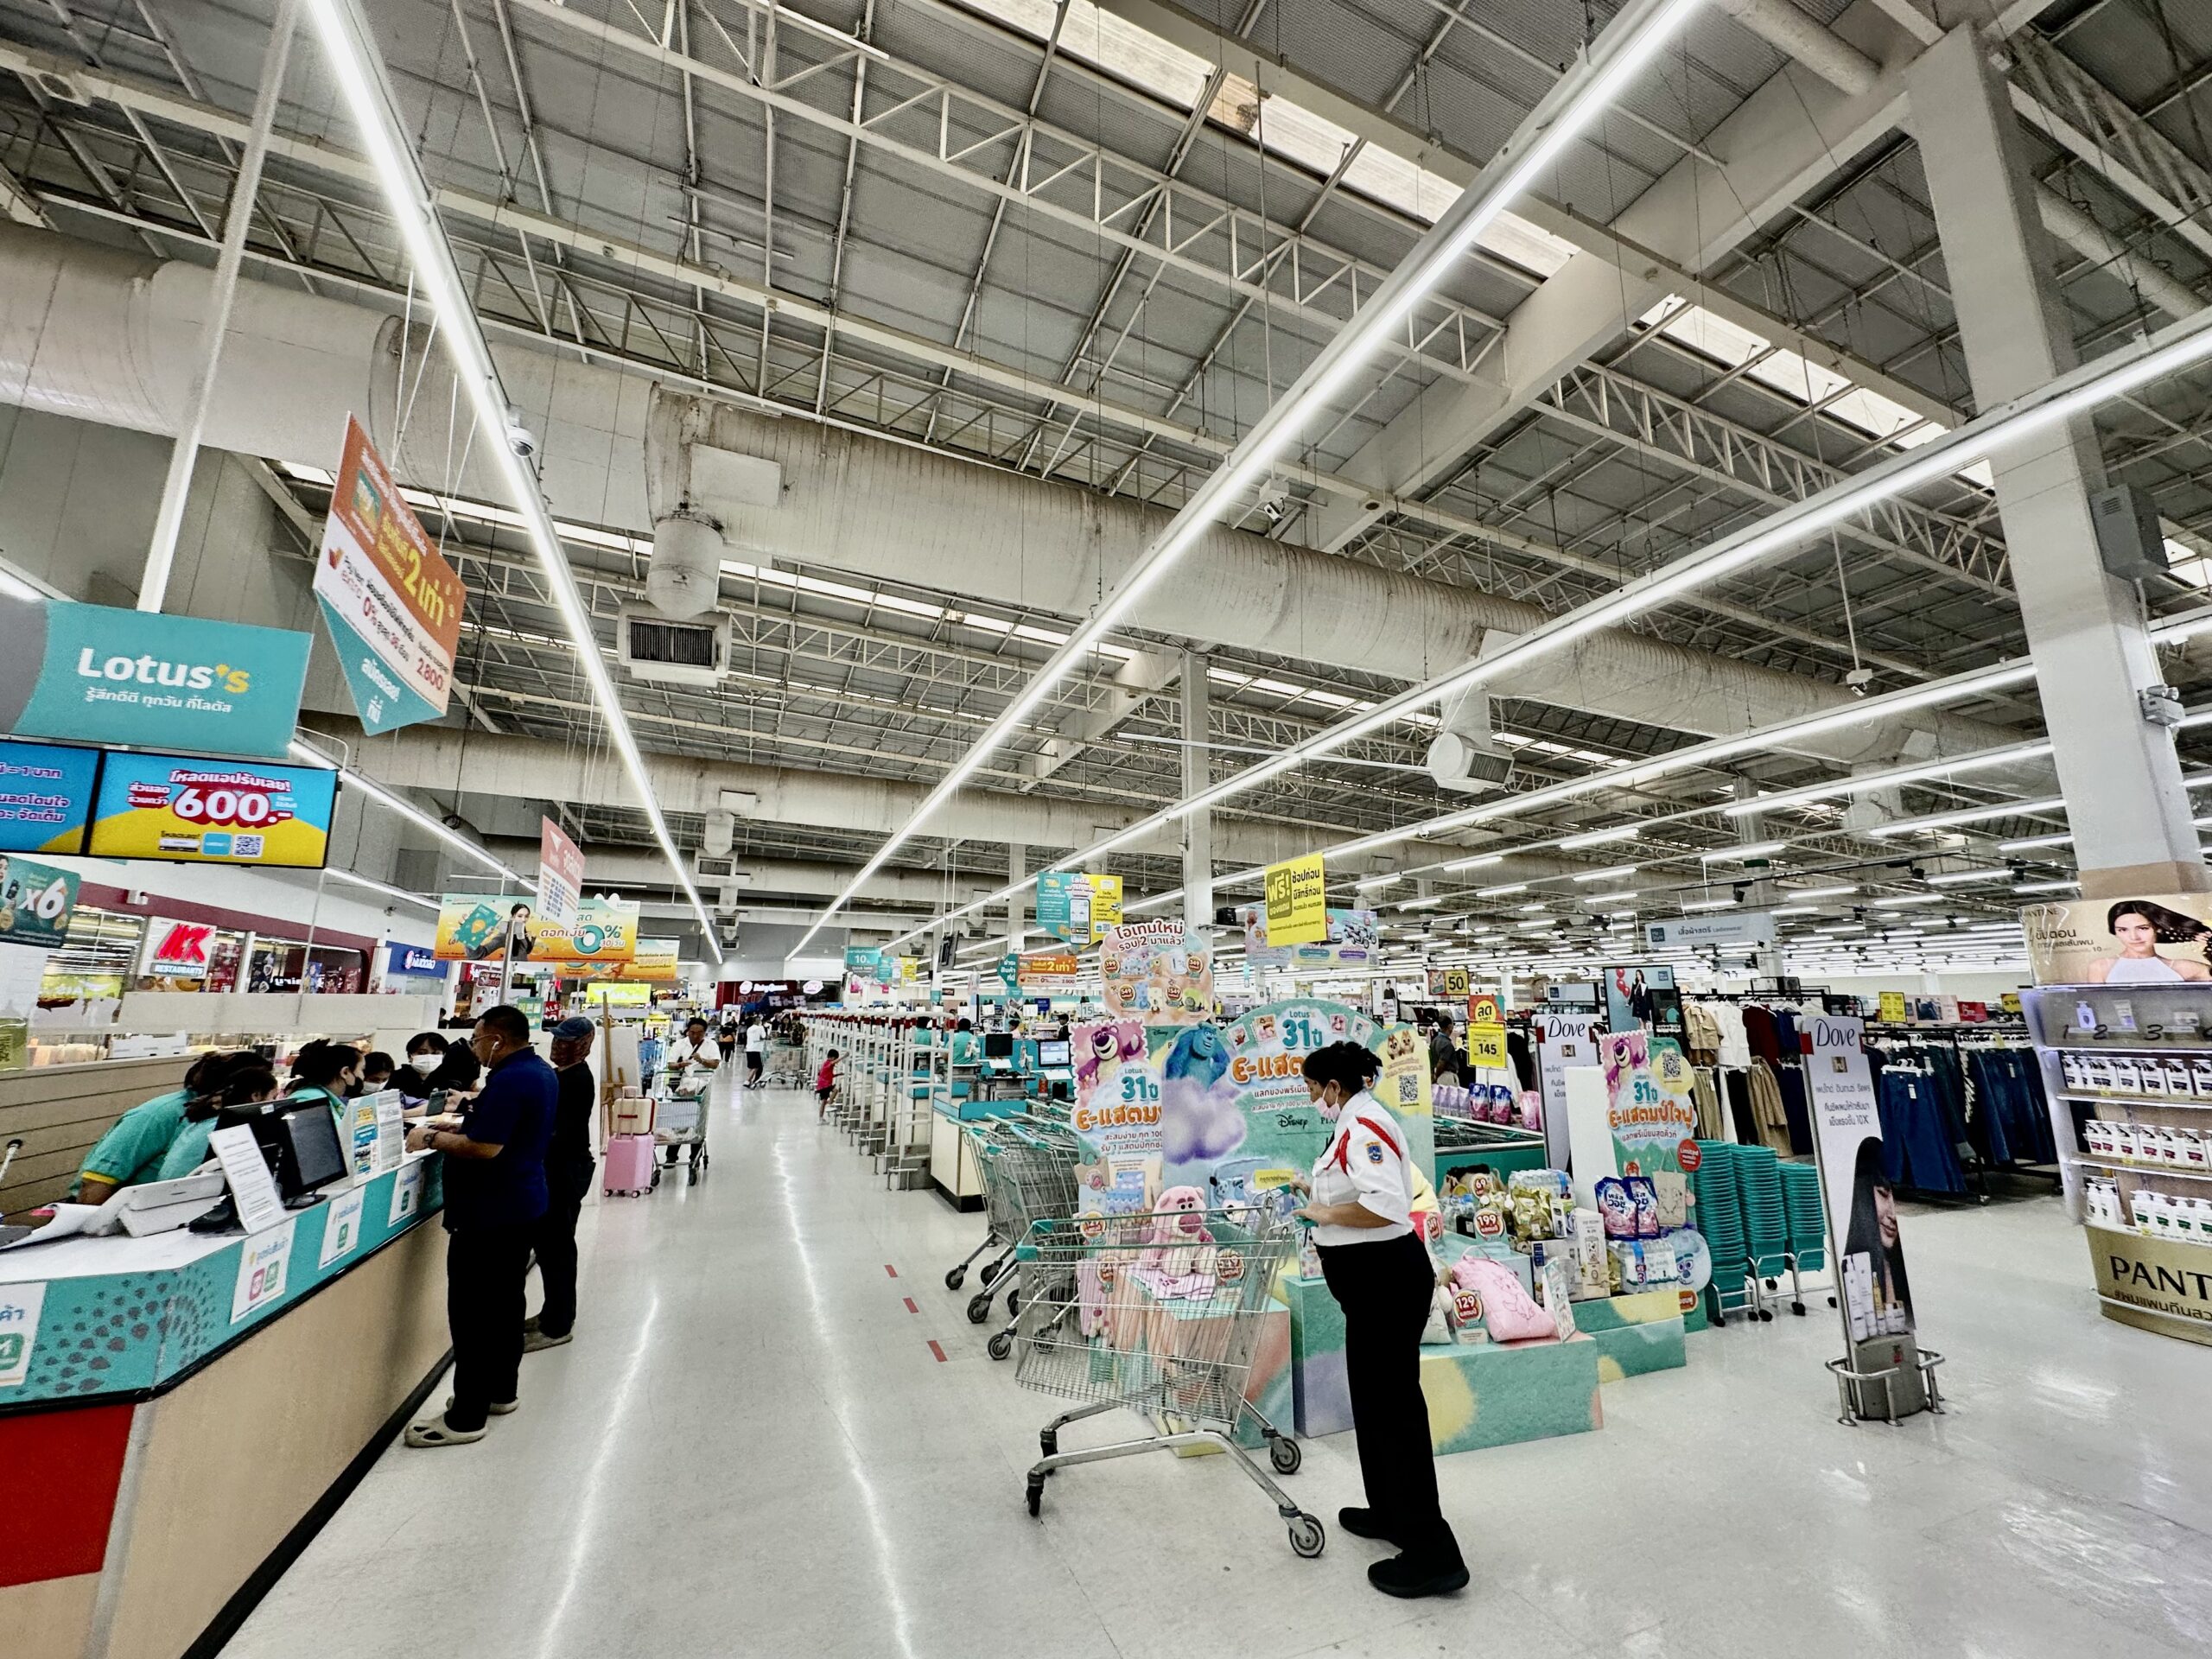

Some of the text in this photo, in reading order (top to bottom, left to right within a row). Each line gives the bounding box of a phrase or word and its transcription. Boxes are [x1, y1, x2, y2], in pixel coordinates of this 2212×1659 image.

[404, 549, 421, 597] 2
[77, 647, 250, 694] Lotus's
[143, 695, 182, 708] ทุกวัน
[186, 694, 233, 713] ที่โลตัส
[1292, 868, 1320, 884] ช้อปก่อน
[1267, 872, 1291, 903] ฟรี!
[1114, 919, 1184, 939] ไอเทมใหม่
[1119, 936, 1185, 951] รอบ 2 มาแล้ว!
[855, 955, 868, 963] 10
[154, 964, 204, 976] RESTAURANTS
[1449, 976, 1465, 991] 50
[1083, 1006, 1093, 1015] 15
[1478, 1005, 1492, 1018] ลด
[1548, 1015, 1586, 1038] Dove
[1815, 1019, 1855, 1046] Dove
[2093, 1024, 2108, 1040] 2
[2144, 1024, 2164, 1041] 3
[1478, 1043, 1497, 1055] 145
[1275, 1114, 1308, 1128] Disney
[1104, 1132, 1137, 1141] สะสมง่าย
[1139, 1131, 1149, 1141] ทุก
[1476, 1179, 1488, 1190] 69
[1478, 1214, 1497, 1226] 199
[1456, 1297, 1474, 1309] 129
